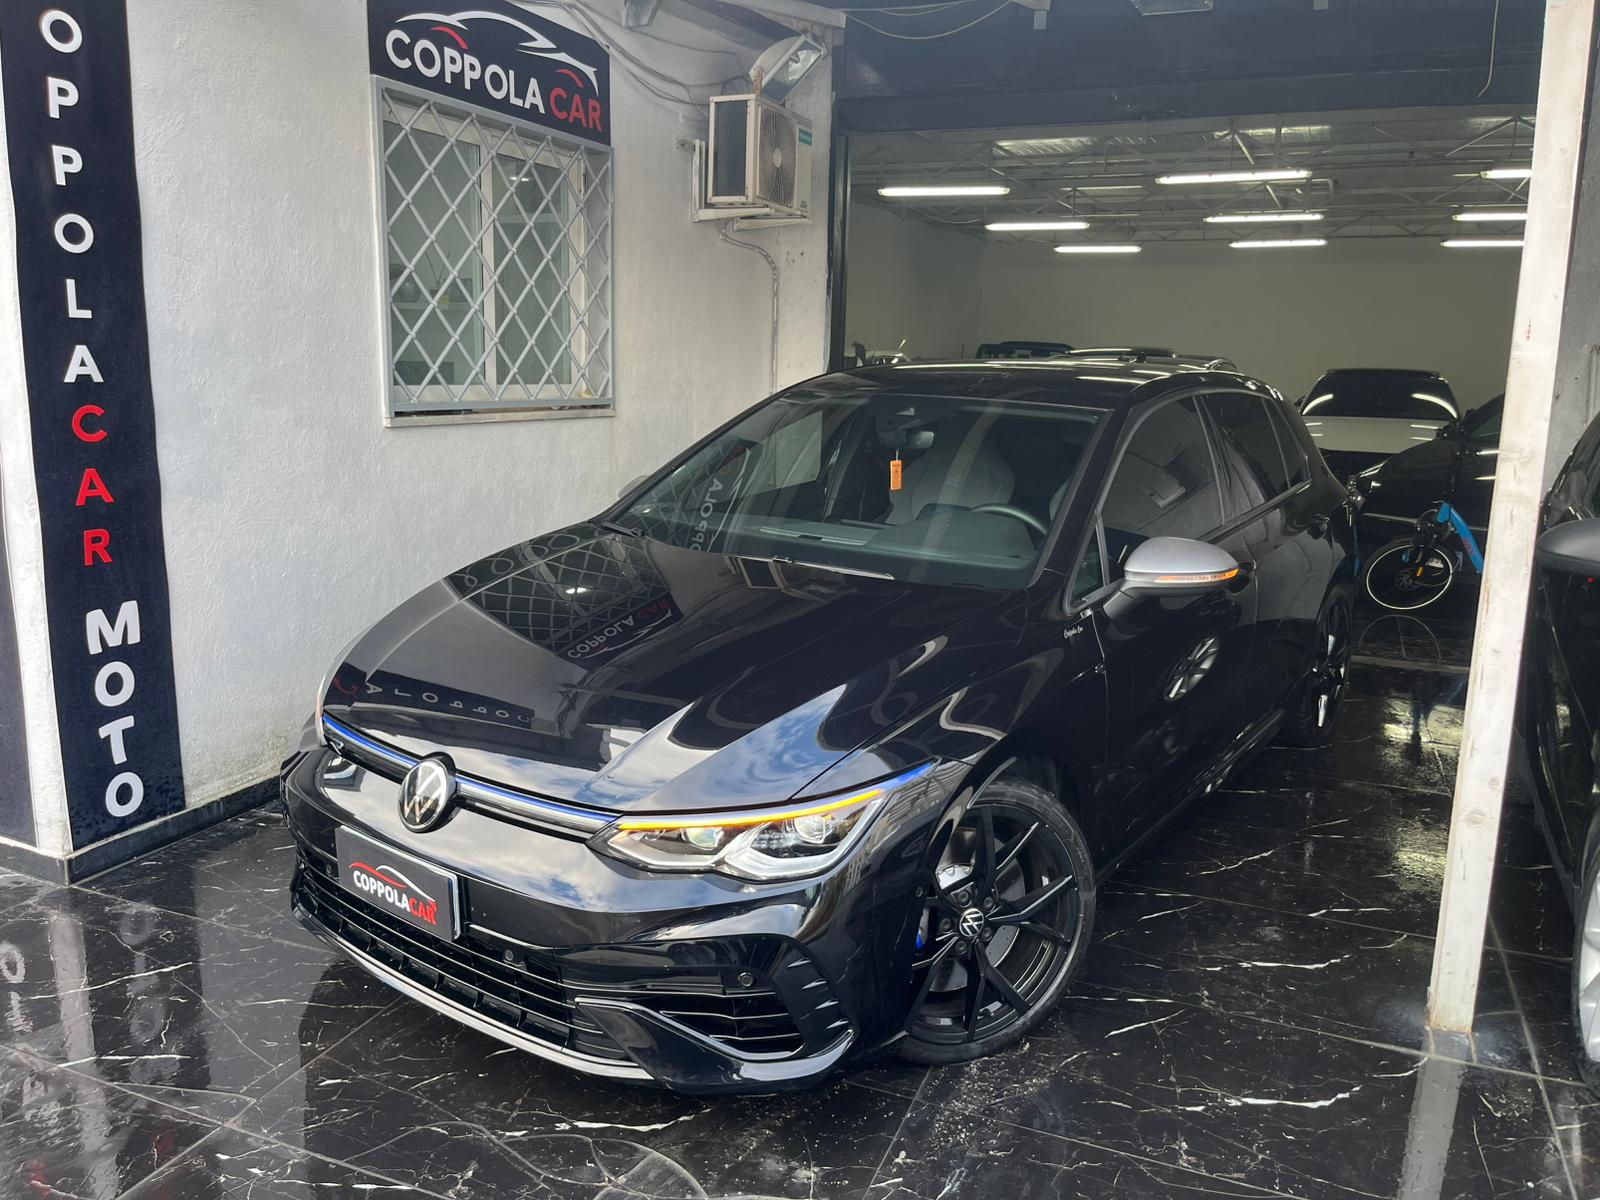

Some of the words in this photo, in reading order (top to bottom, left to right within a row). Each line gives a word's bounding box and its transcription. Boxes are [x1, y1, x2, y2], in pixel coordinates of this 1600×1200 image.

[385, 29, 546, 115] COPPOLA
[550, 87, 603, 132] CAR
[71, 404, 114, 566] CAR
[86, 600, 144, 818] MOTO
